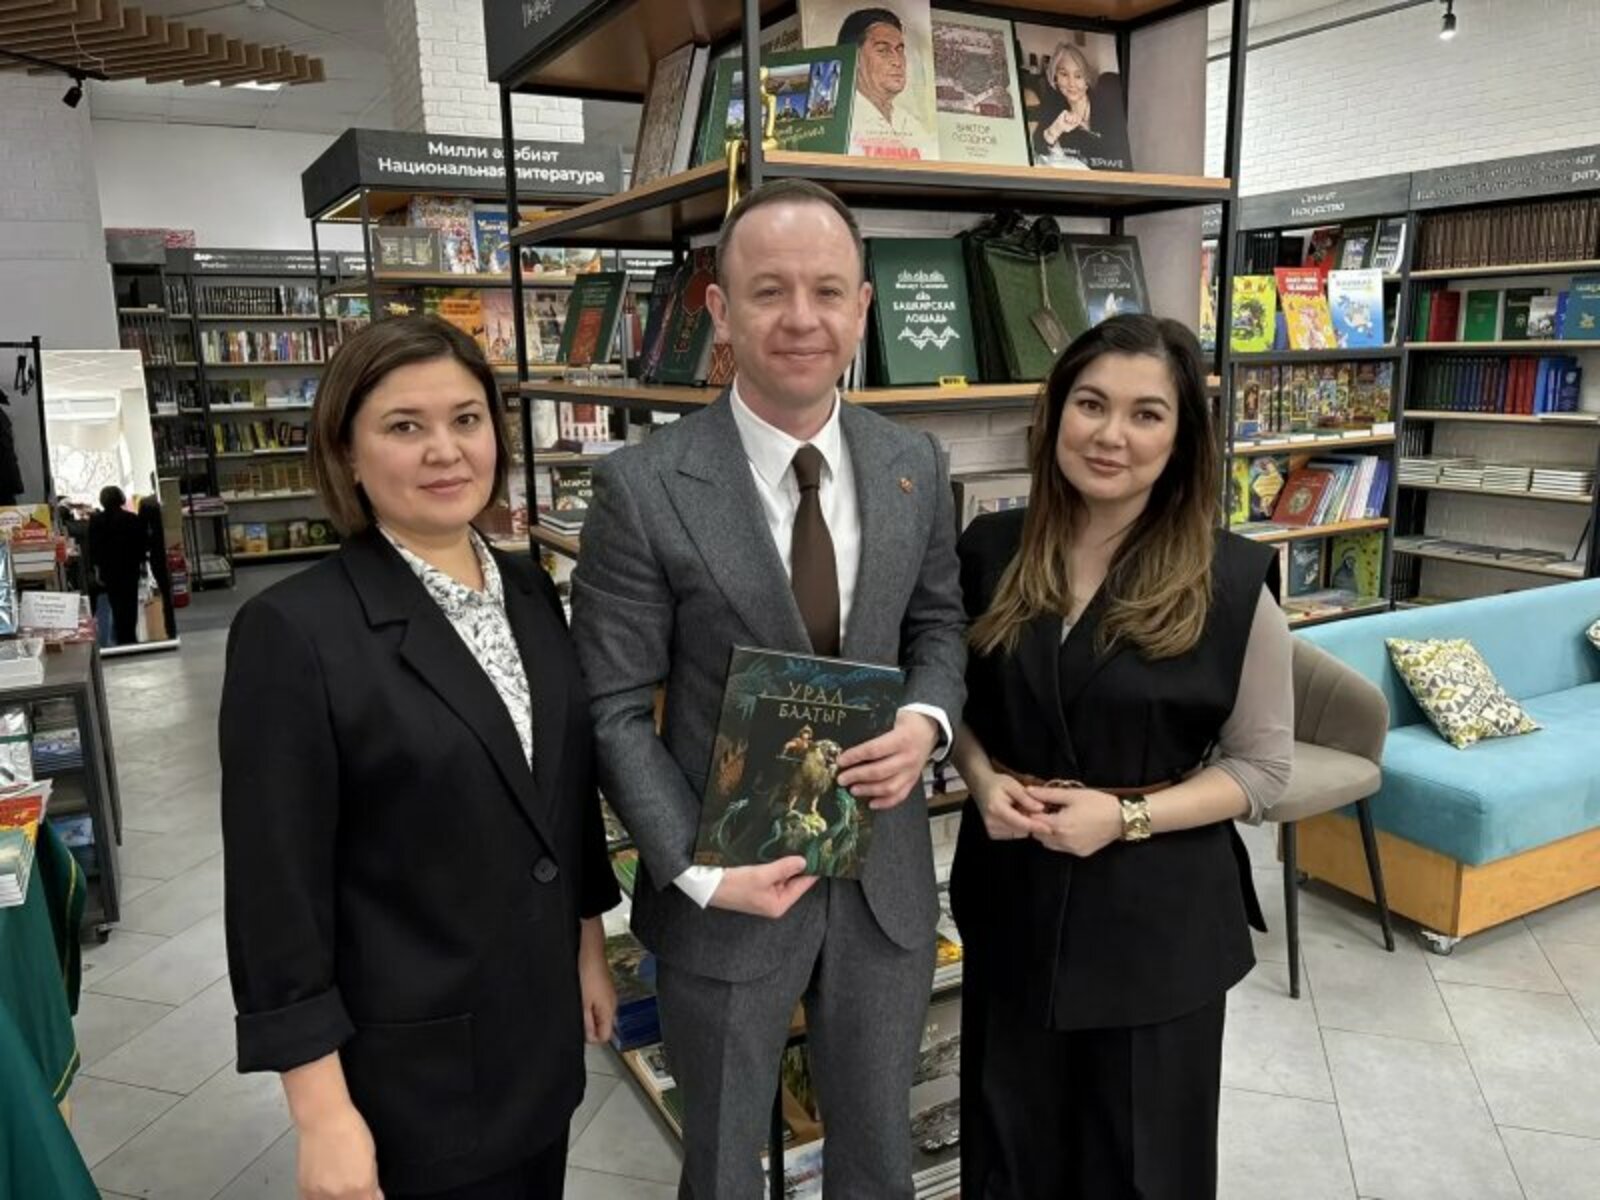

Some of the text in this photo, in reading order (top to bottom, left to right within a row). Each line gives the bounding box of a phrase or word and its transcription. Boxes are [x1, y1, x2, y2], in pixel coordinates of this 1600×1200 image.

[428, 141, 488, 159] Милли
[377, 158, 507, 178] Национальная
[893, 301, 956, 311] БАШКИРСКАЯ
[905, 313, 948, 324] ЛОШАДЬ
[789, 681, 844, 705] УРАЛ
[777, 703, 847, 726] БААТЫР
